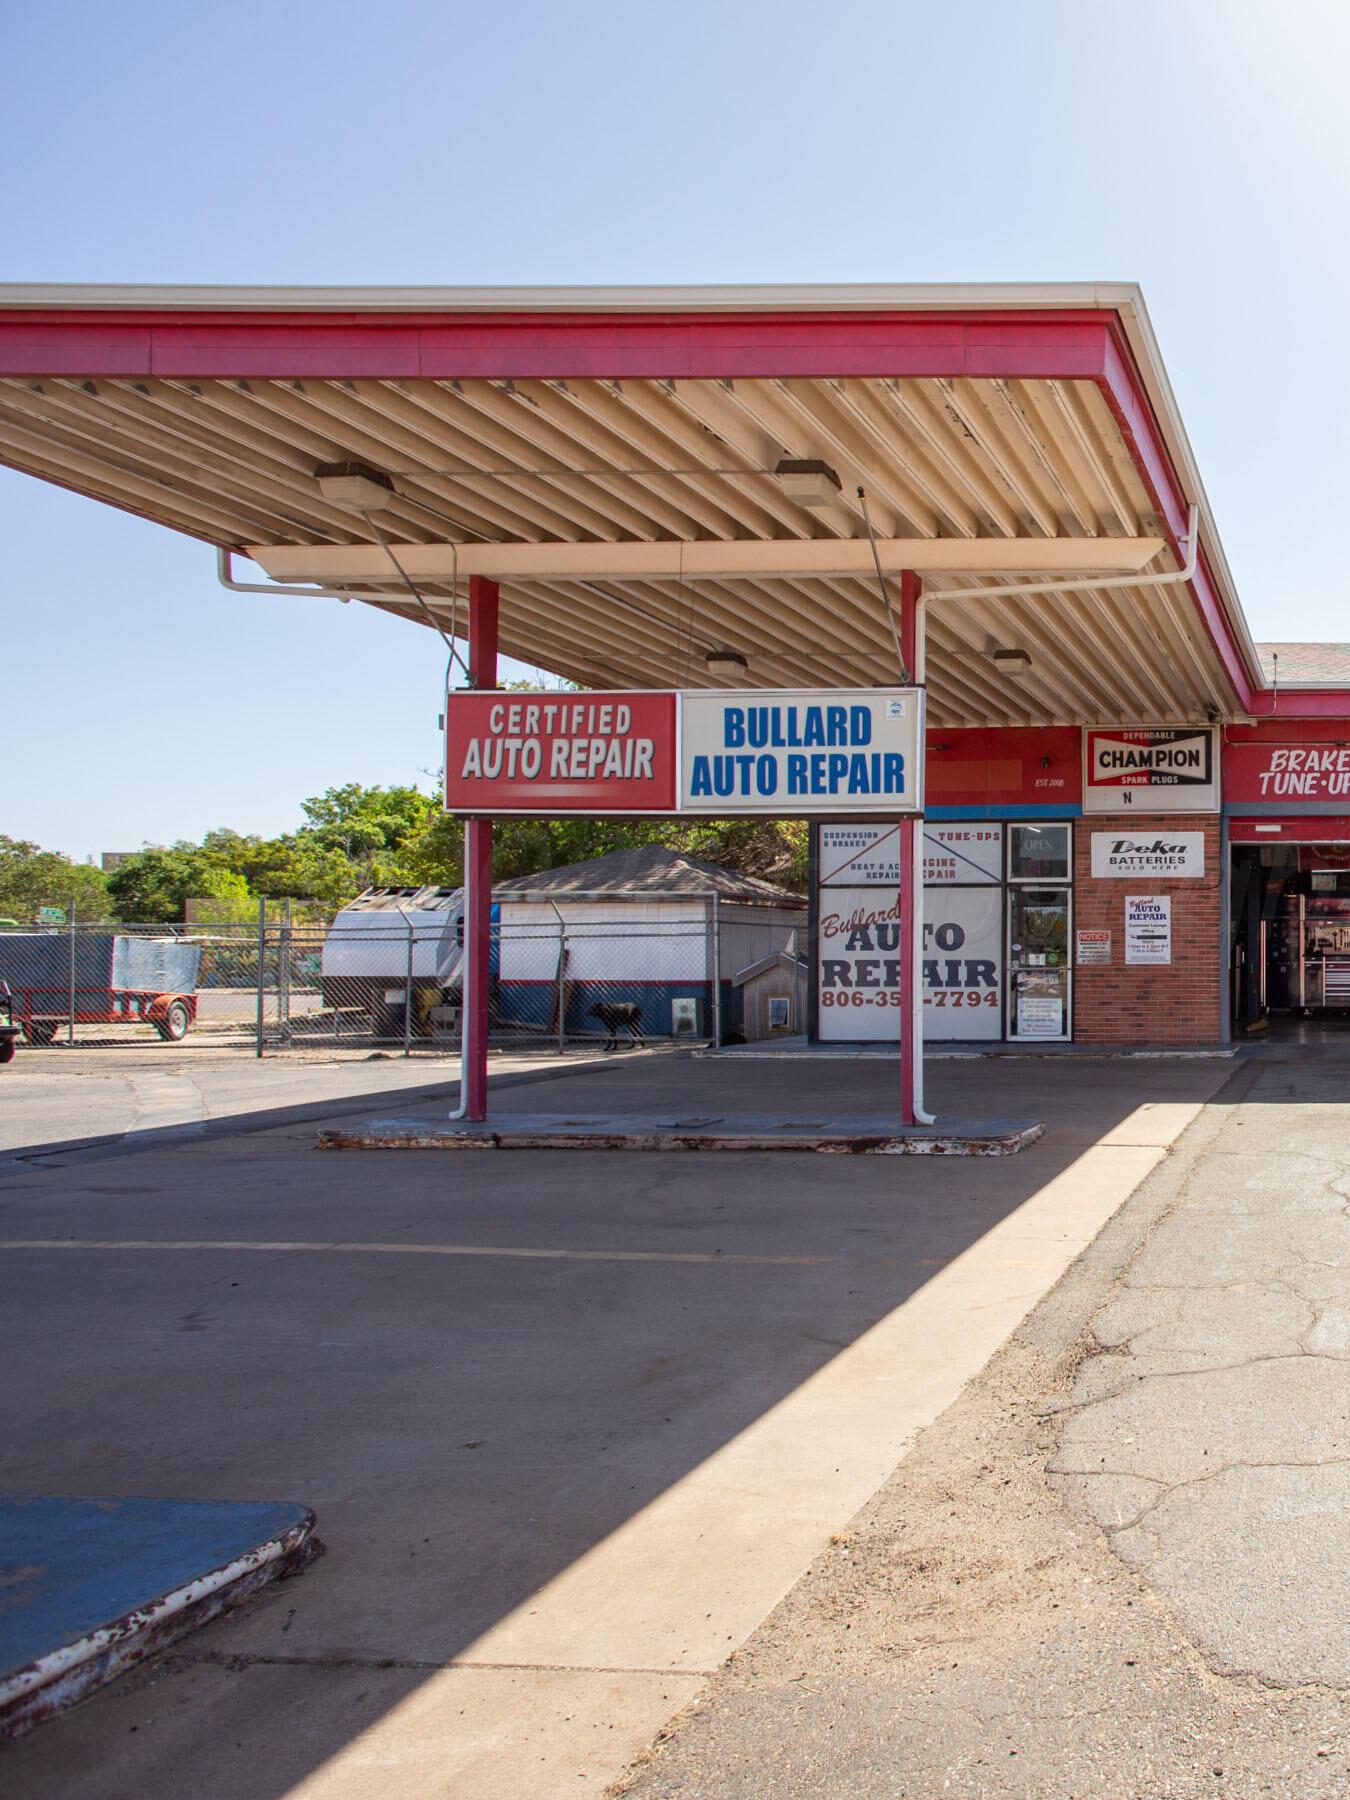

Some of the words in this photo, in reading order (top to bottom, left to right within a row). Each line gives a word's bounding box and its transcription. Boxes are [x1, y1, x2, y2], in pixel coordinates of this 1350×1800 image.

[490, 704, 631, 735] CERTIFIED
[724, 706, 872, 748] BULLARD
[1123, 732, 1175, 740] DEPENDABLE
[461, 738, 541, 780] AUTO
[550, 738, 655, 780] REPAIR
[1099, 750, 1200, 769] CHAMPION
[690, 755, 778, 796] AUTO
[787, 753, 905, 795] REPAIR
[1121, 776, 1148, 784] SPARK
[1151, 776, 1178, 784] PLUGS
[938, 832, 1000, 841] TUNE-UPS
[1111, 840, 1187, 855] Deka
[923, 859, 956, 867] GINE
[1109, 856, 1186, 865] BATTERIES
[923, 870, 956, 878] PAIR
[821, 892, 901, 938] Bullard
[822, 991, 998, 1007] 806-35-7794
